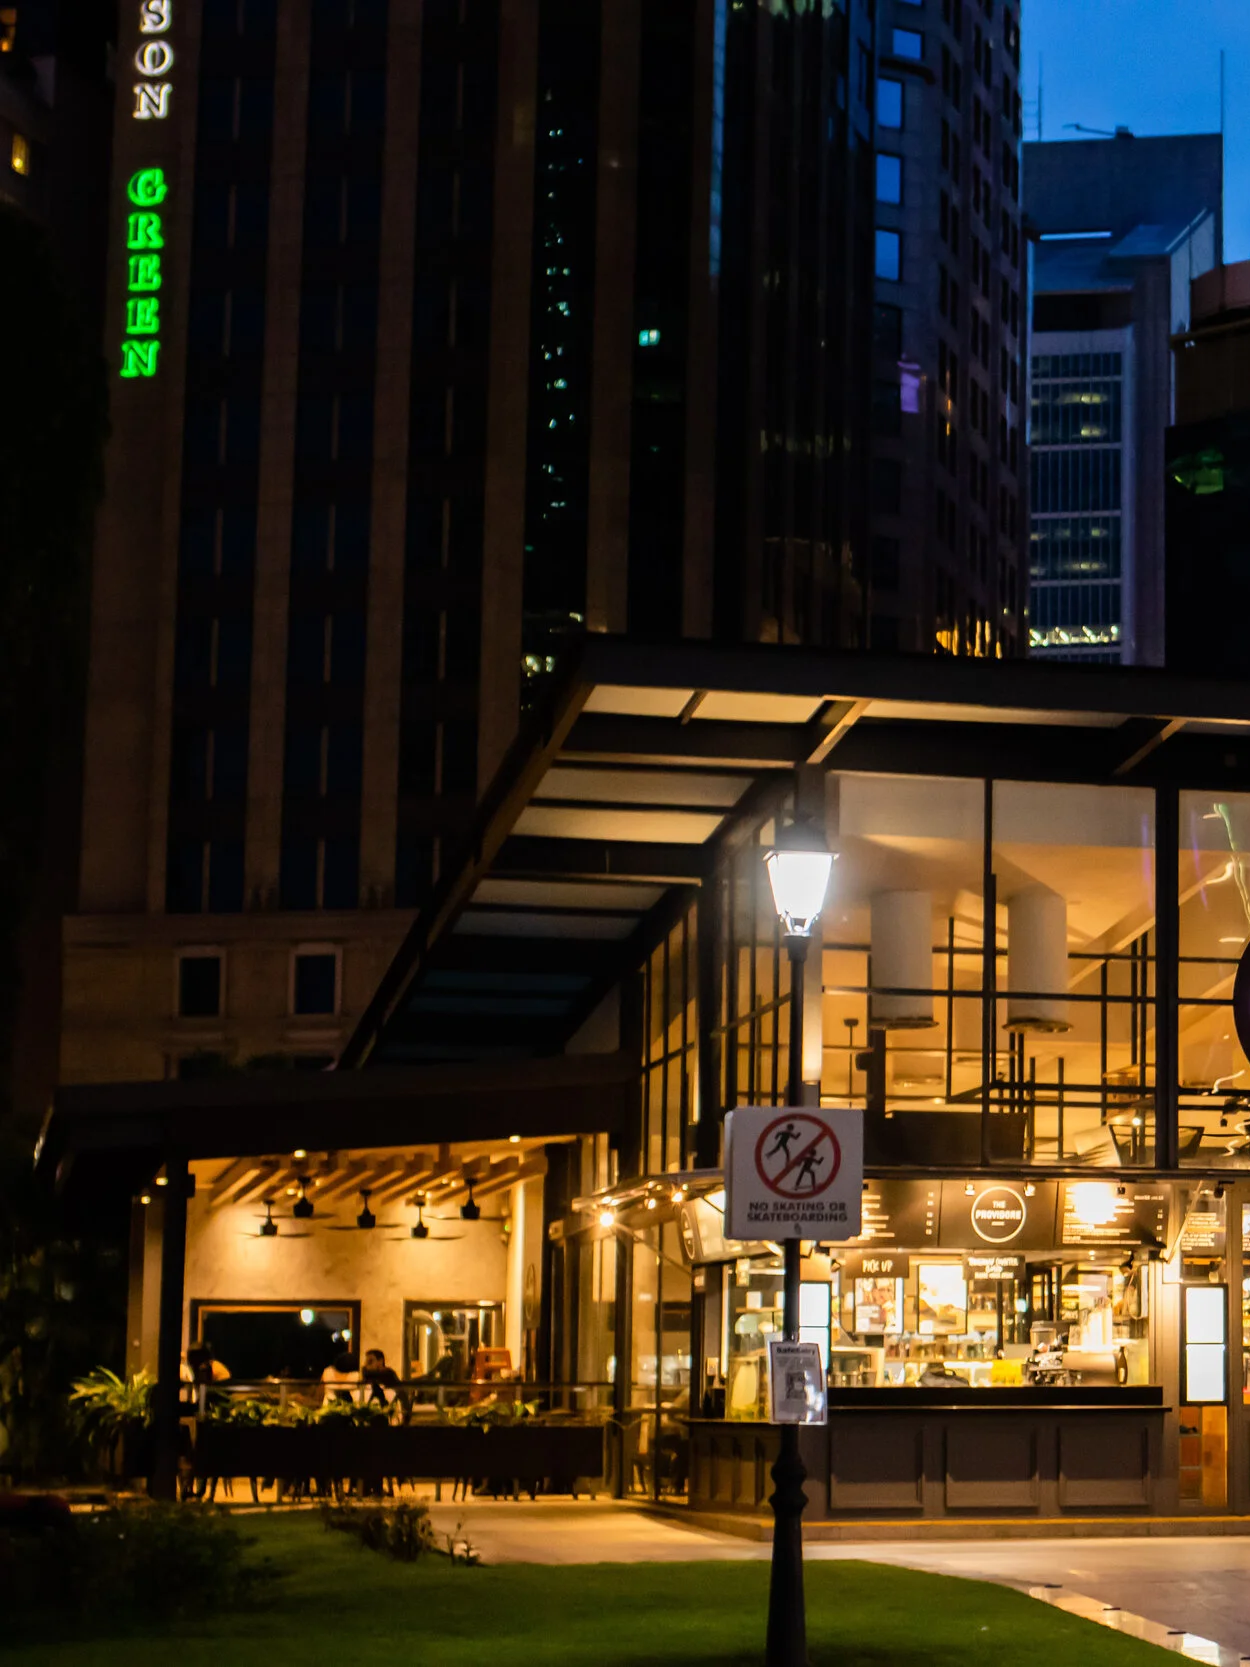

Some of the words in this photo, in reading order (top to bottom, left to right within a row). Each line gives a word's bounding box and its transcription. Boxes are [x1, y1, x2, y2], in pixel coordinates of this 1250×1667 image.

[120, 168, 168, 378] GREEN
[749, 1202, 769, 1212] NO
[772, 1202, 825, 1212] SKATING
[829, 1202, 847, 1212] OR
[992, 1200, 1006, 1208] THE
[747, 1212, 848, 1223] SKATEBOARDING
[975, 1209, 1022, 1220] PROVIDORE
[862, 1259, 879, 1273] PICK
[881, 1259, 893, 1273] UP
